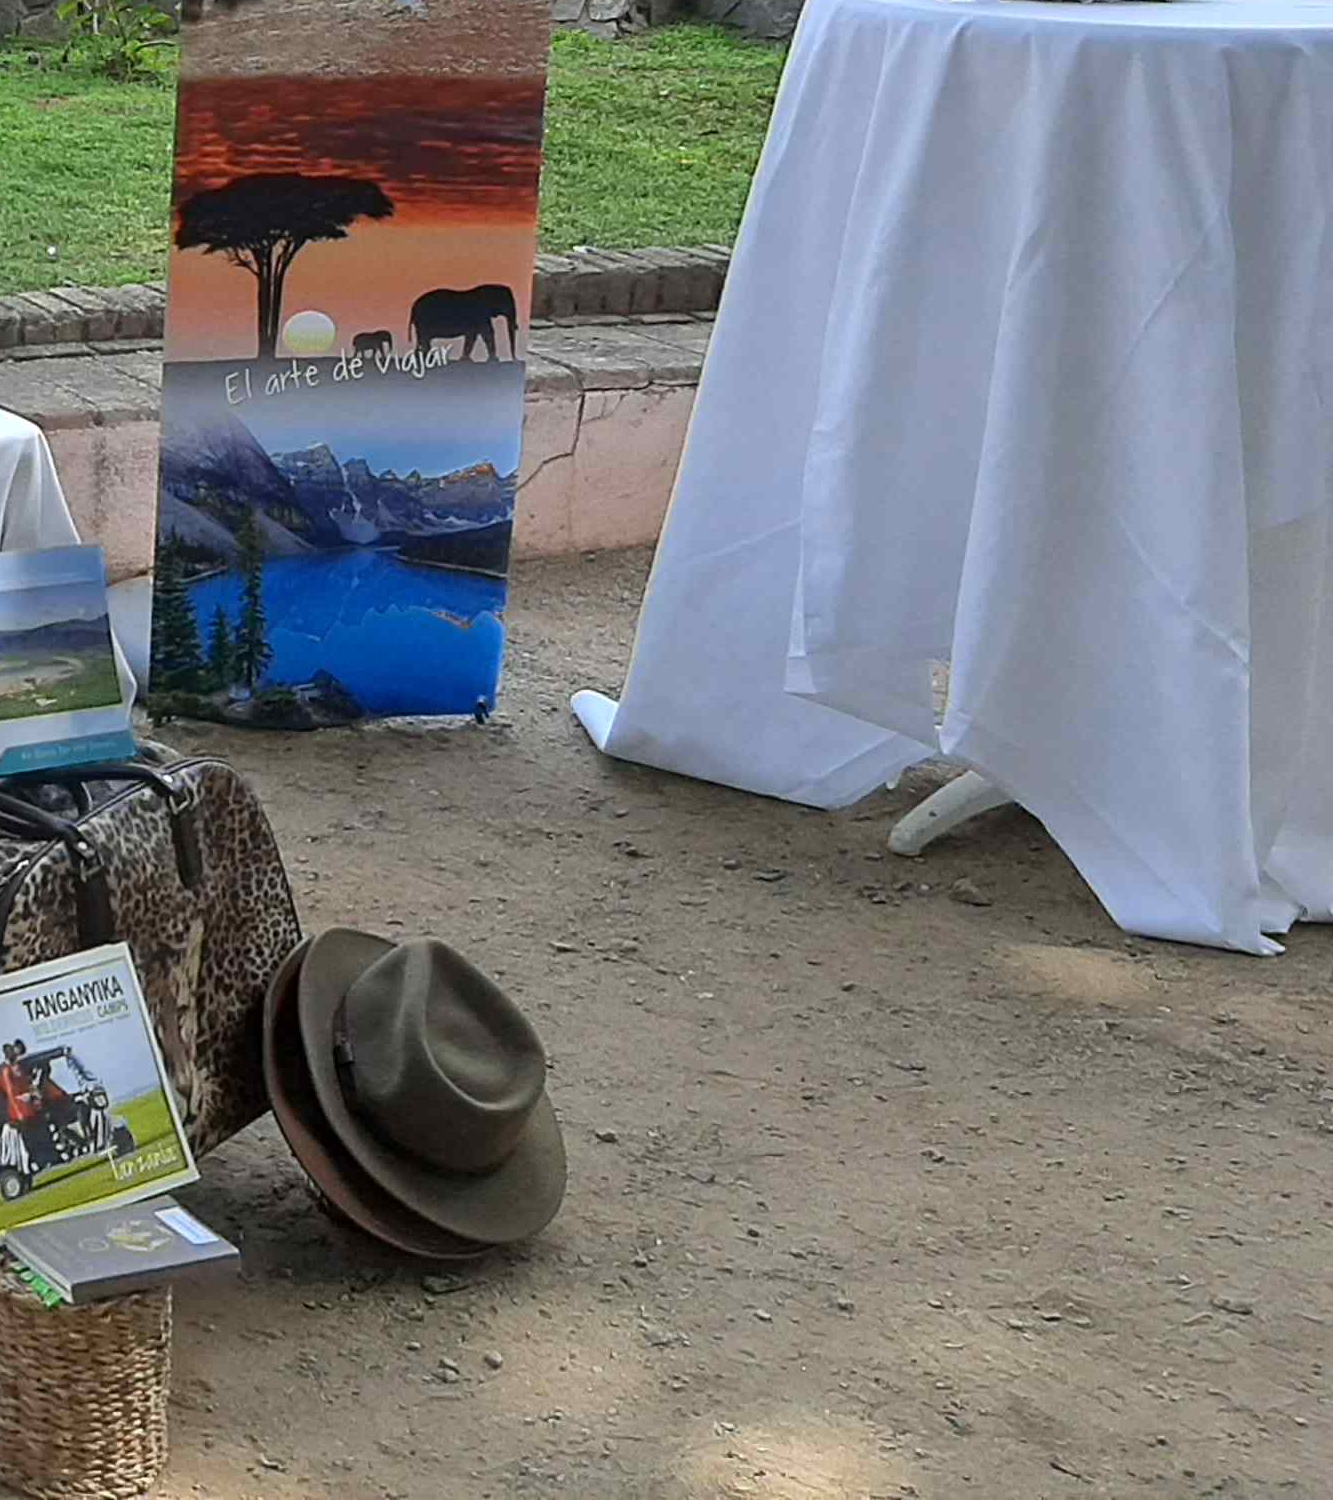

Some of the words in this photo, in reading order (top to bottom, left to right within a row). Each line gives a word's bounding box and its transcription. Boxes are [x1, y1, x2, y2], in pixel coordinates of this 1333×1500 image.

[225, 368, 252, 404] El
[265, 360, 319, 396] arte
[333, 348, 364, 381] de
[22, 975, 124, 1021] TANGANYIKA
